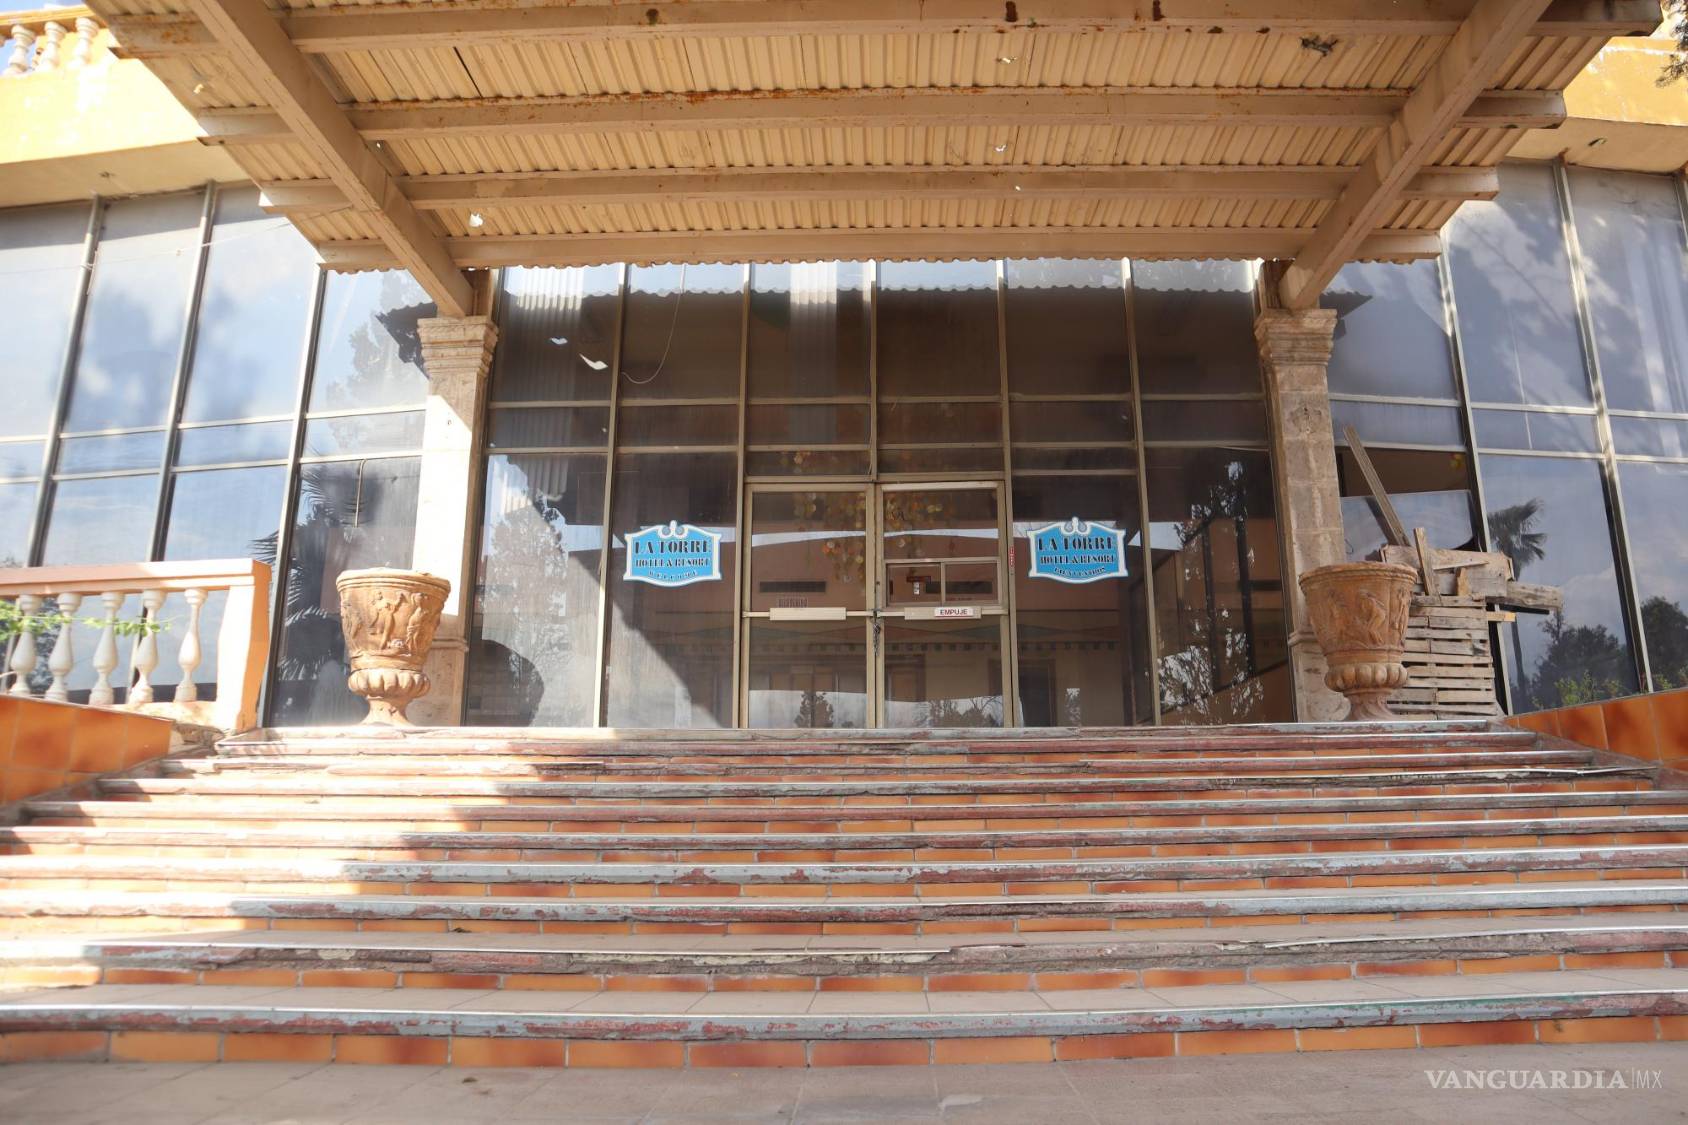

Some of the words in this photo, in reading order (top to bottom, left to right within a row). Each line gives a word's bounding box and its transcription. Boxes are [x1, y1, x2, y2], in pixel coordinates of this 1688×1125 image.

[634, 540, 655, 554] LA
[657, 540, 711, 553] TORRE
[1038, 537, 1058, 551] LA
[1062, 536, 1113, 550] TORRE
[635, 558, 664, 568] HOTEL
[666, 558, 673, 567] &
[675, 557, 710, 567] RESORT
[1040, 555, 1070, 565] HOTEL
[1071, 555, 1079, 564] &
[1080, 554, 1115, 564] RESORT
